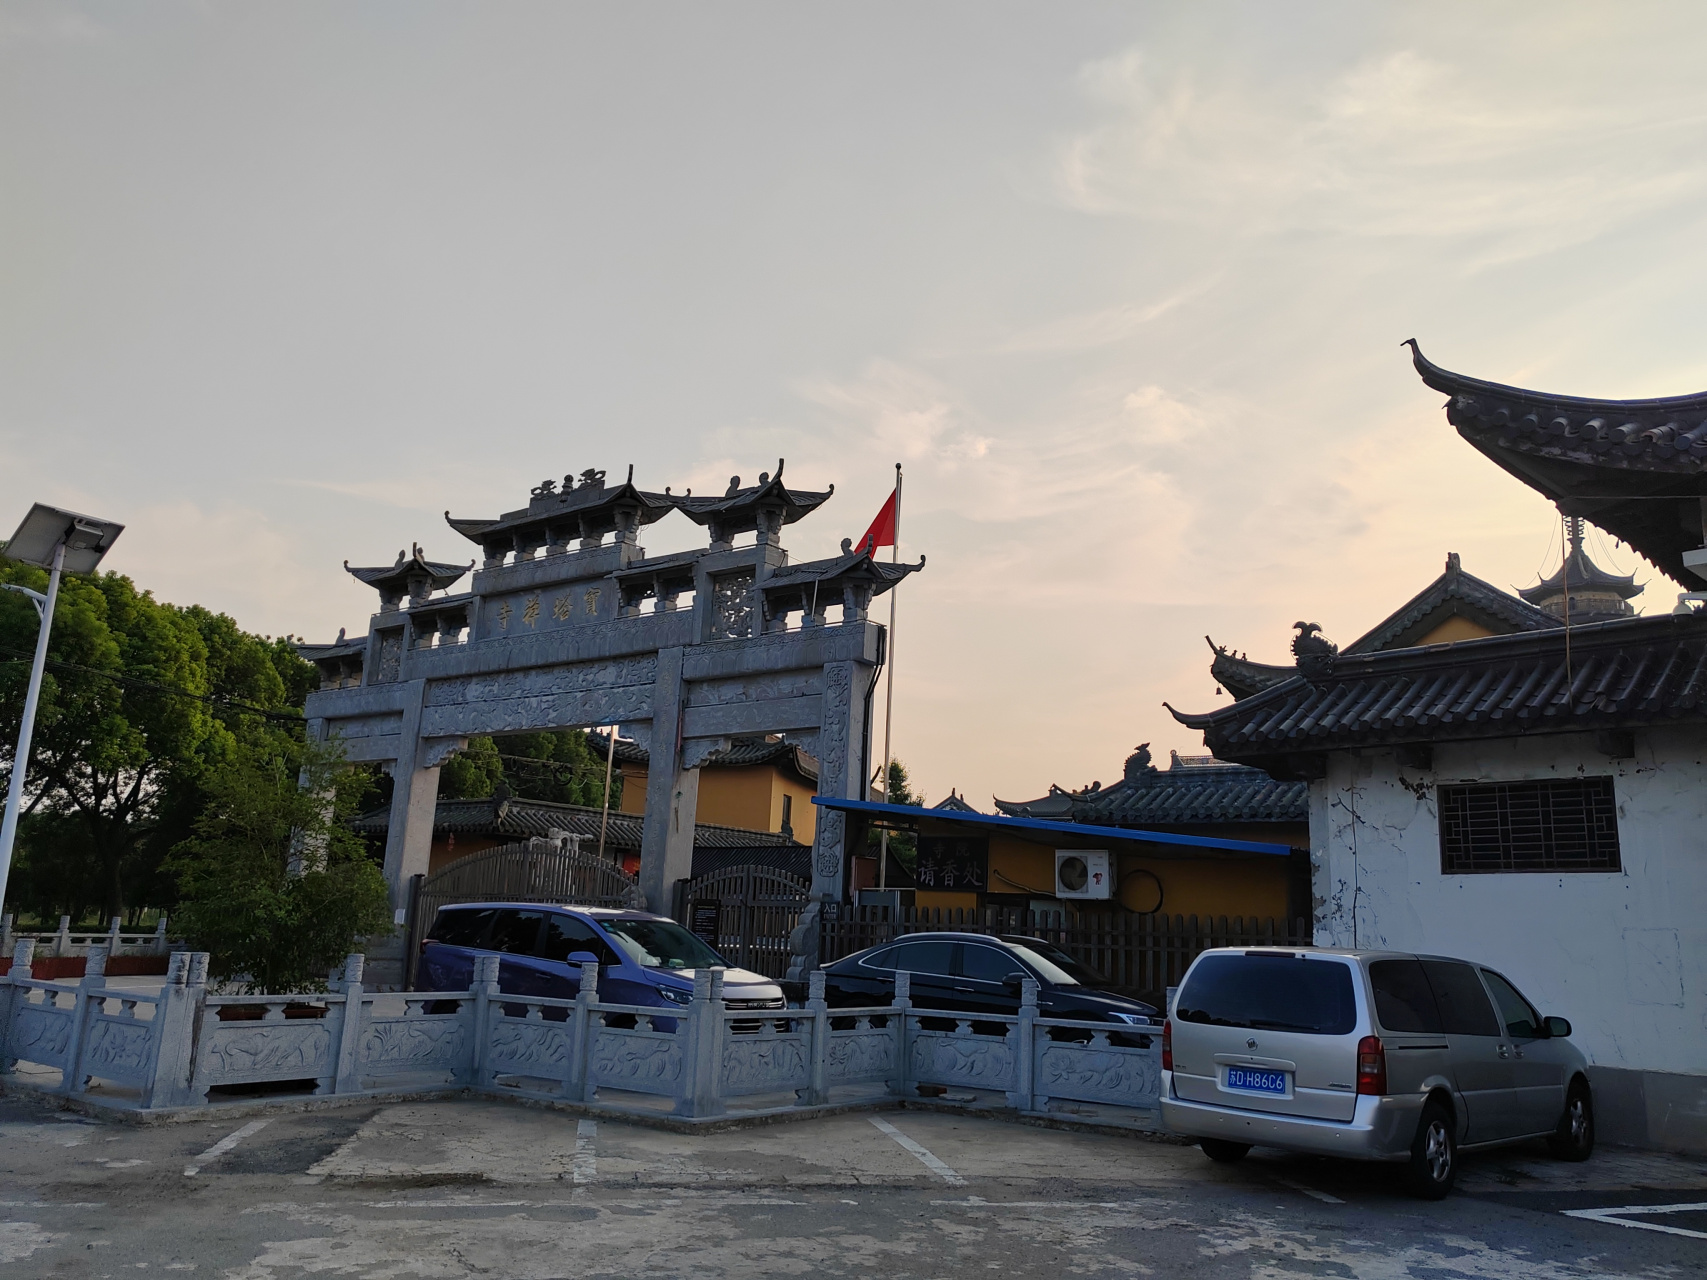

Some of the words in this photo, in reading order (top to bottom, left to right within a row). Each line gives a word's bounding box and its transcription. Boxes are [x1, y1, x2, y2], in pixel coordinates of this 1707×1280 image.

[932, 841, 970, 859] 寺院
[918, 856, 984, 887] 请香处
[823, 902, 837, 913] 入口
